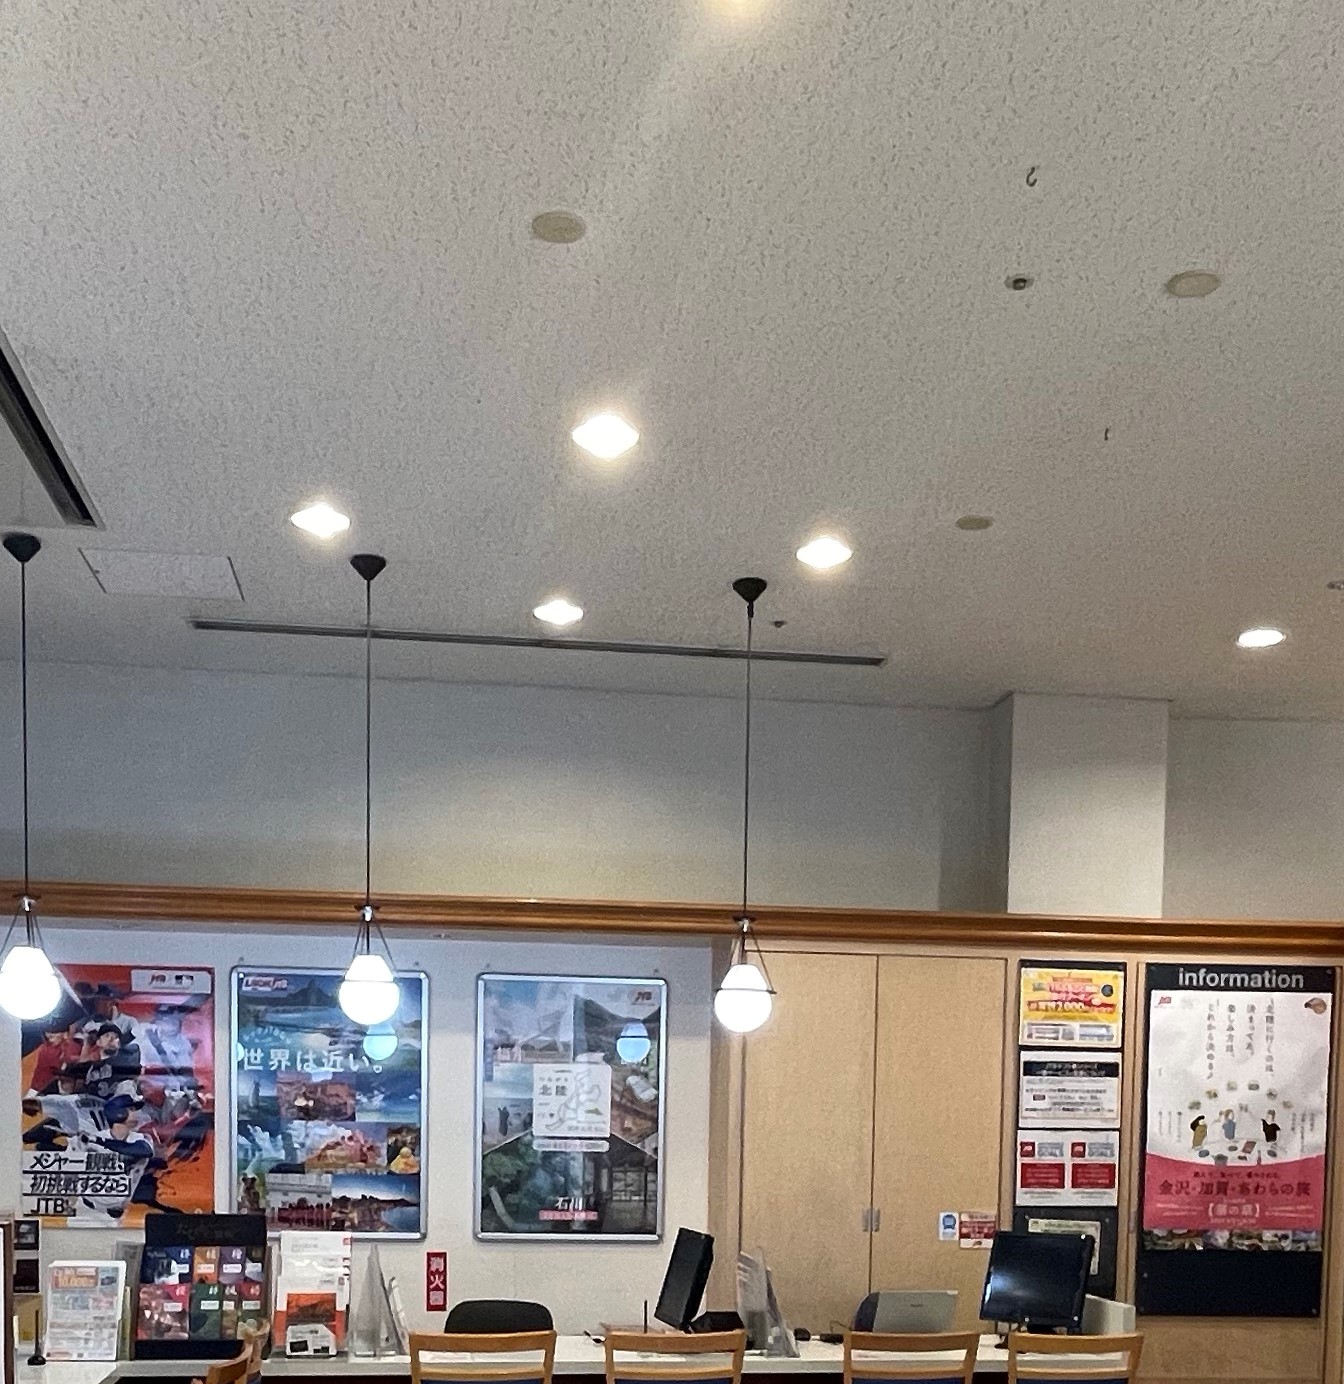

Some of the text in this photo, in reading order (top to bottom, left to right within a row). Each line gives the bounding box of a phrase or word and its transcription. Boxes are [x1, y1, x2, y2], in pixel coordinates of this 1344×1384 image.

[1178, 967, 1304, 989] information
[243, 1048, 384, 1074] 世界は近い。
